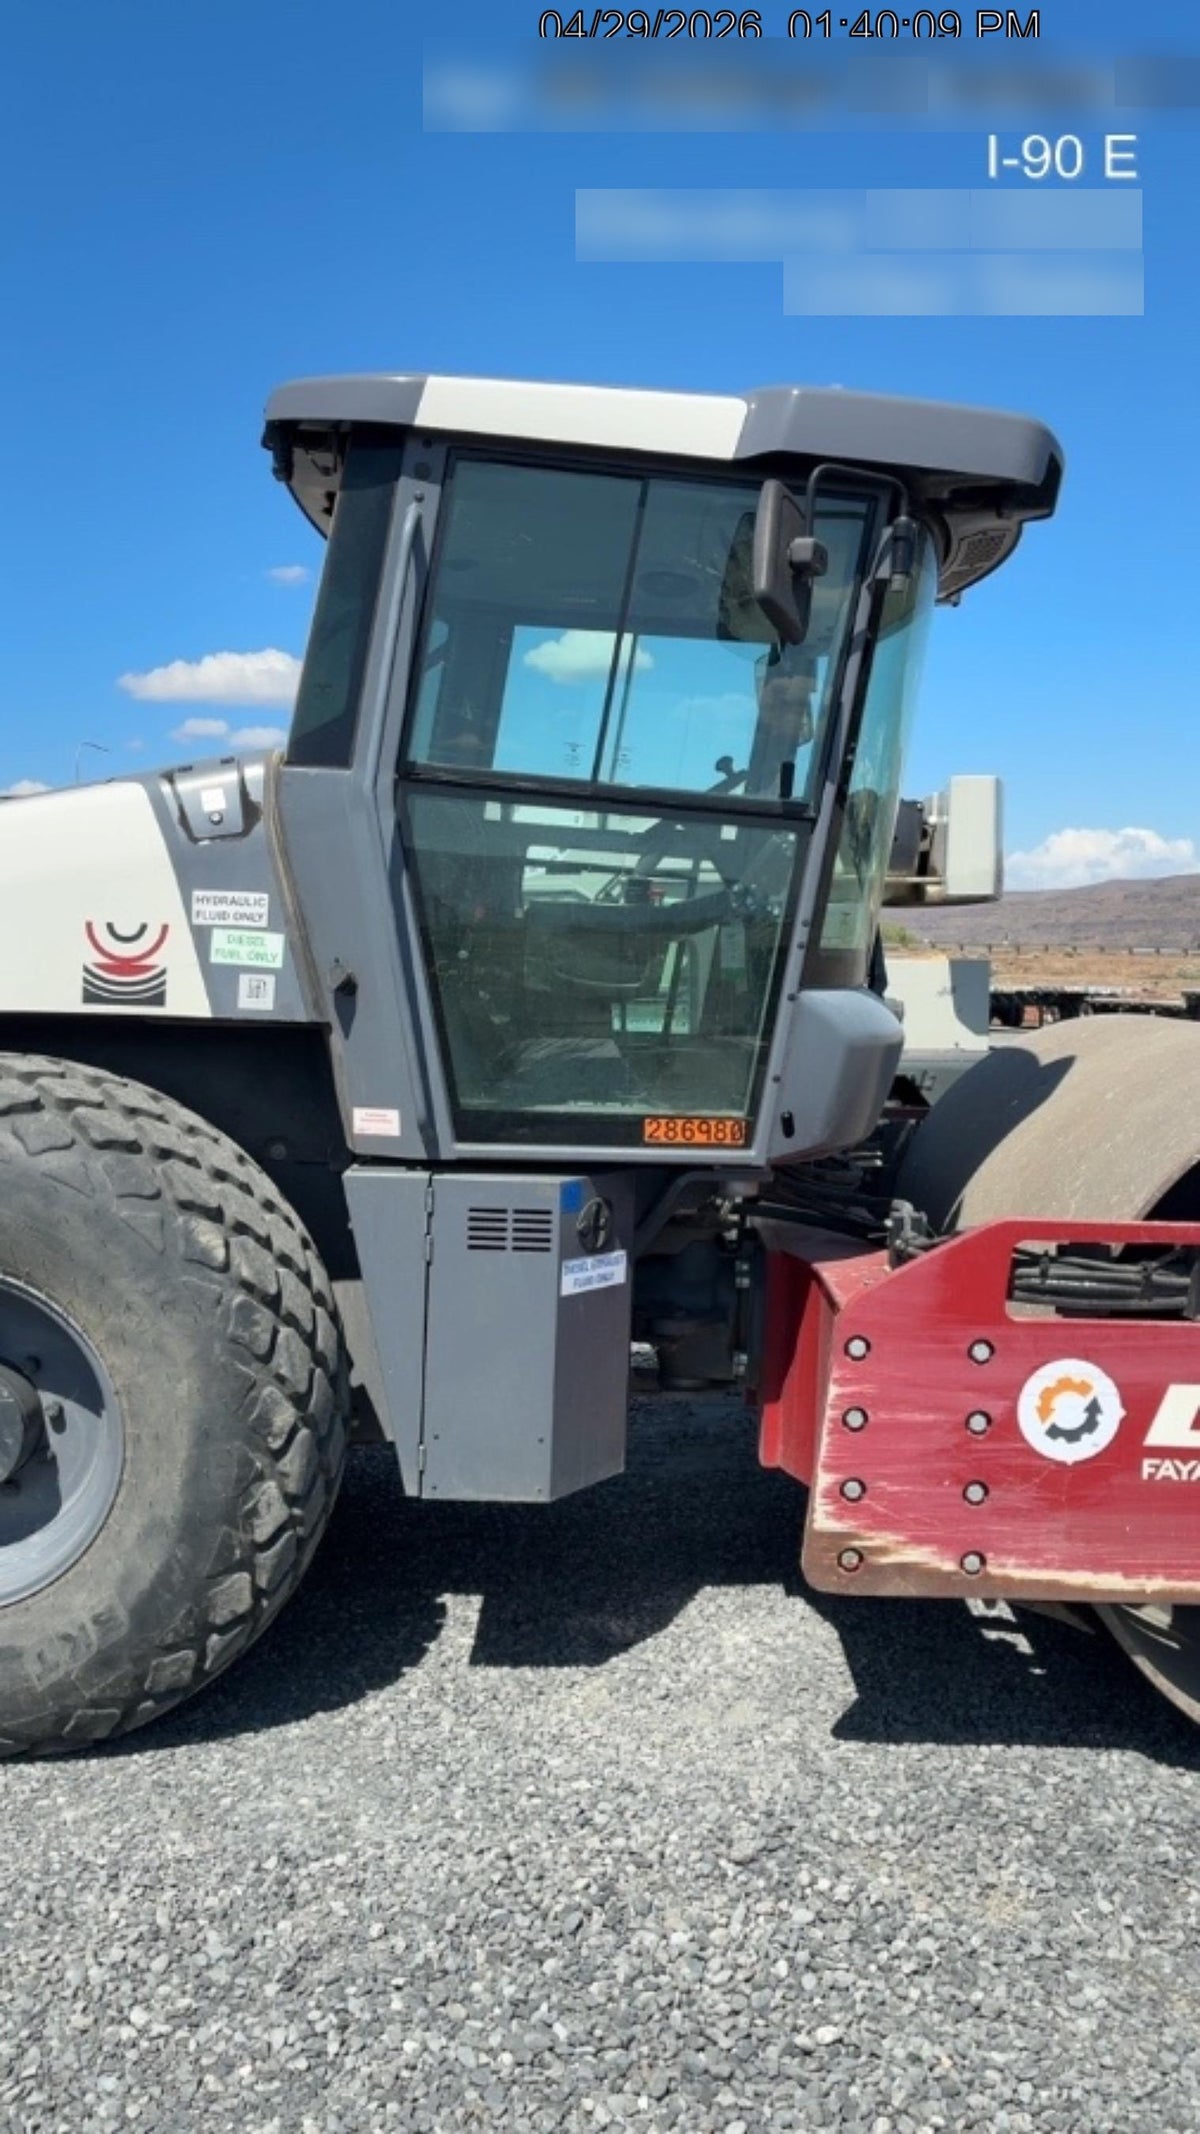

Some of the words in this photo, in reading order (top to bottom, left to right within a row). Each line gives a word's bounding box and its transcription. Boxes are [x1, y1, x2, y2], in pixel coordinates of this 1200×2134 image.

[196, 895, 267, 908] HYDRAULIC
[196, 910, 231, 921] FLUID
[232, 911, 265, 923] ONLY
